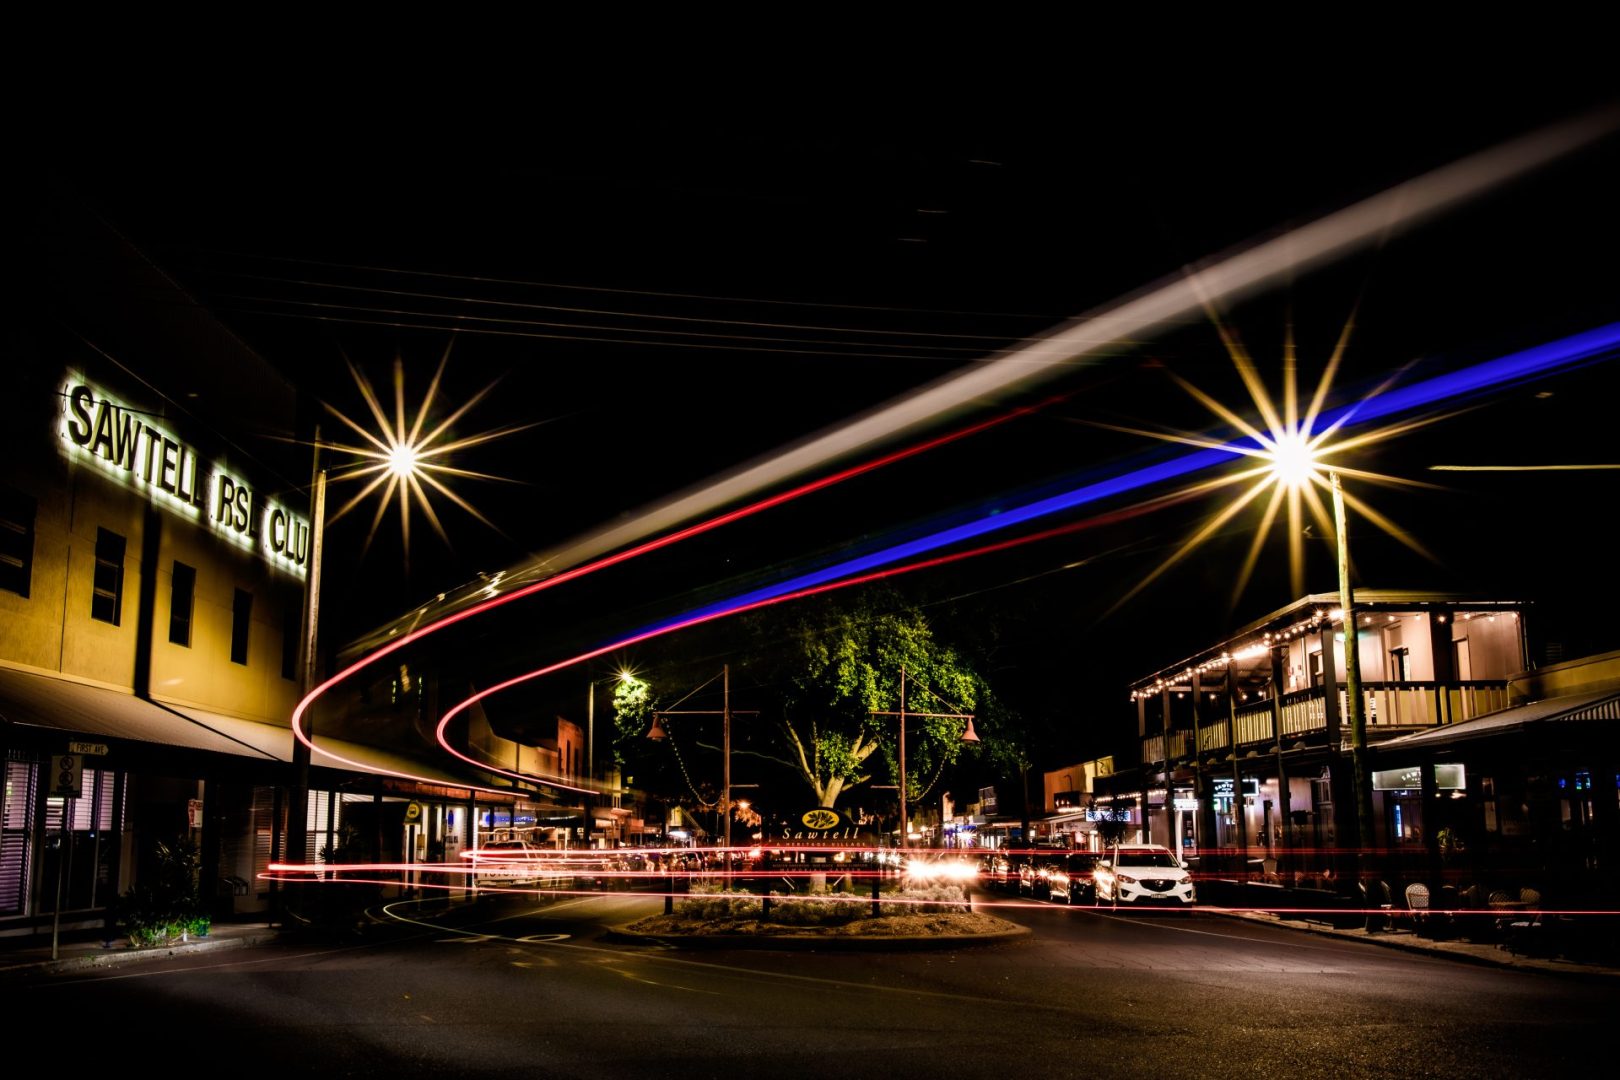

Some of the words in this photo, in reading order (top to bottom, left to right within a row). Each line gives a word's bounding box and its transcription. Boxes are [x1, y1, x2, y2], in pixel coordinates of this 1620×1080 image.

[68, 385, 200, 508] SAWTELL
[216, 474, 256, 538] RSL
[269, 508, 308, 567] CLU
[76, 743, 92, 753] FIRST
[781, 827, 860, 840] Sawtell
